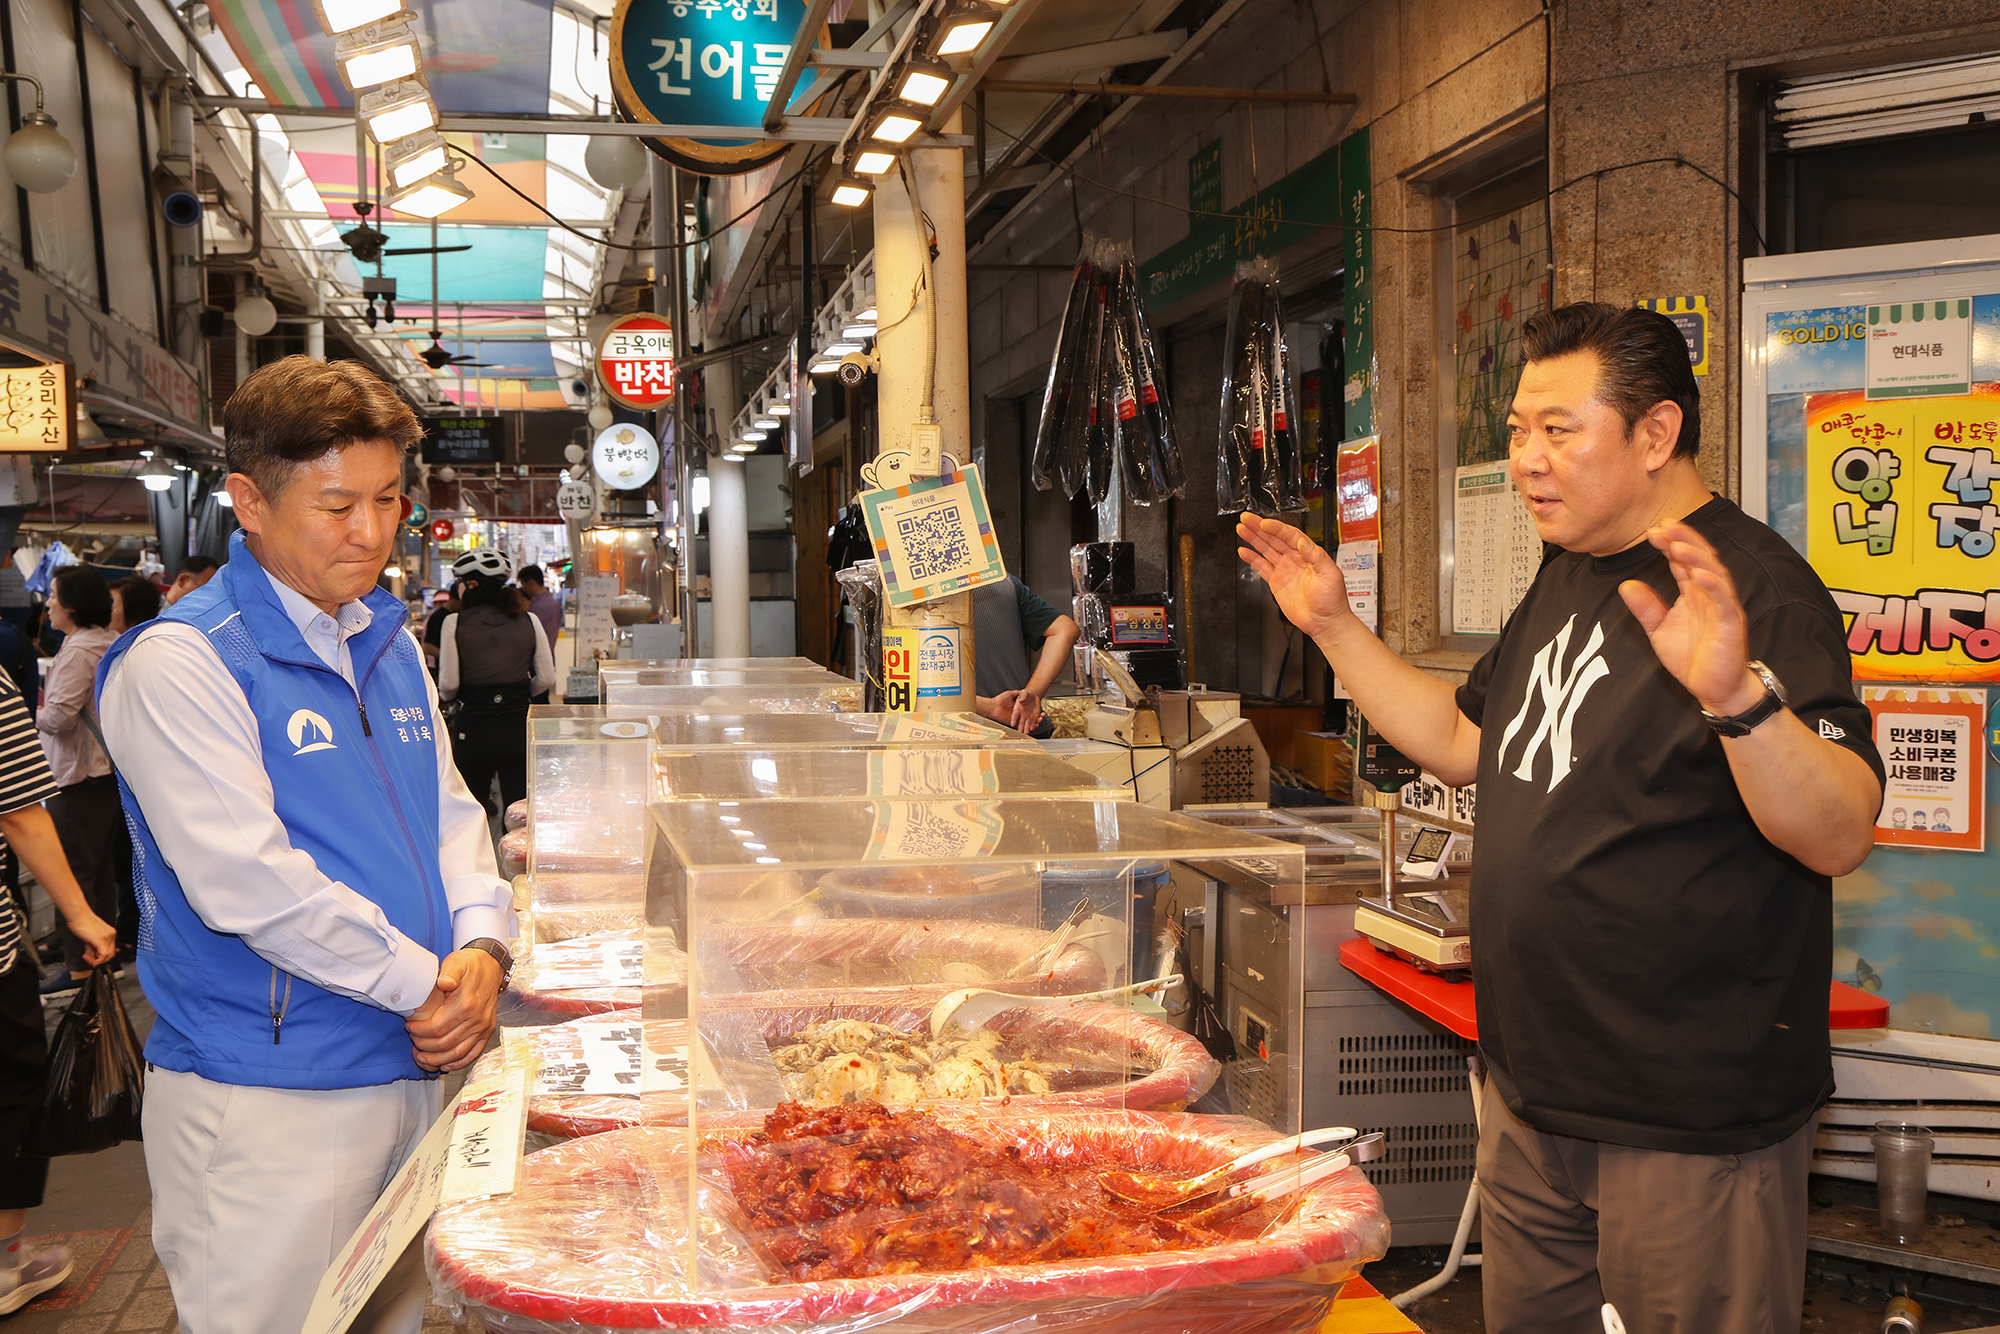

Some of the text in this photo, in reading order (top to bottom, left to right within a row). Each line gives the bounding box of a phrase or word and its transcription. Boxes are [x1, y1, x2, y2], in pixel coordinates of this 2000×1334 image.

[647, 37, 792, 102] 건어물
[1777, 324, 1840, 345] GOLD
[613, 335, 672, 354] 금옥이네
[1892, 343, 1943, 359] 현대식품
[615, 361, 673, 395] 반찬
[38, 369, 60, 444] 승리수산
[560, 494, 591, 510] 반찬
[911, 495, 936, 507] 현대식품
[1832, 446, 1902, 557] 양념
[1925, 445, 2000, 559] 간장
[1128, 617, 1164, 630] 곱창김
[919, 648, 955, 661] 전통시장
[919, 660, 955, 672] 화재공제
[921, 673, 956, 684] 가입점포
[1498, 612, 1611, 794] NY
[1890, 728, 1957, 744] 민생회복
[1889, 746, 1957, 763] 소비쿠폰
[1889, 765, 1957, 782] 사용매장
